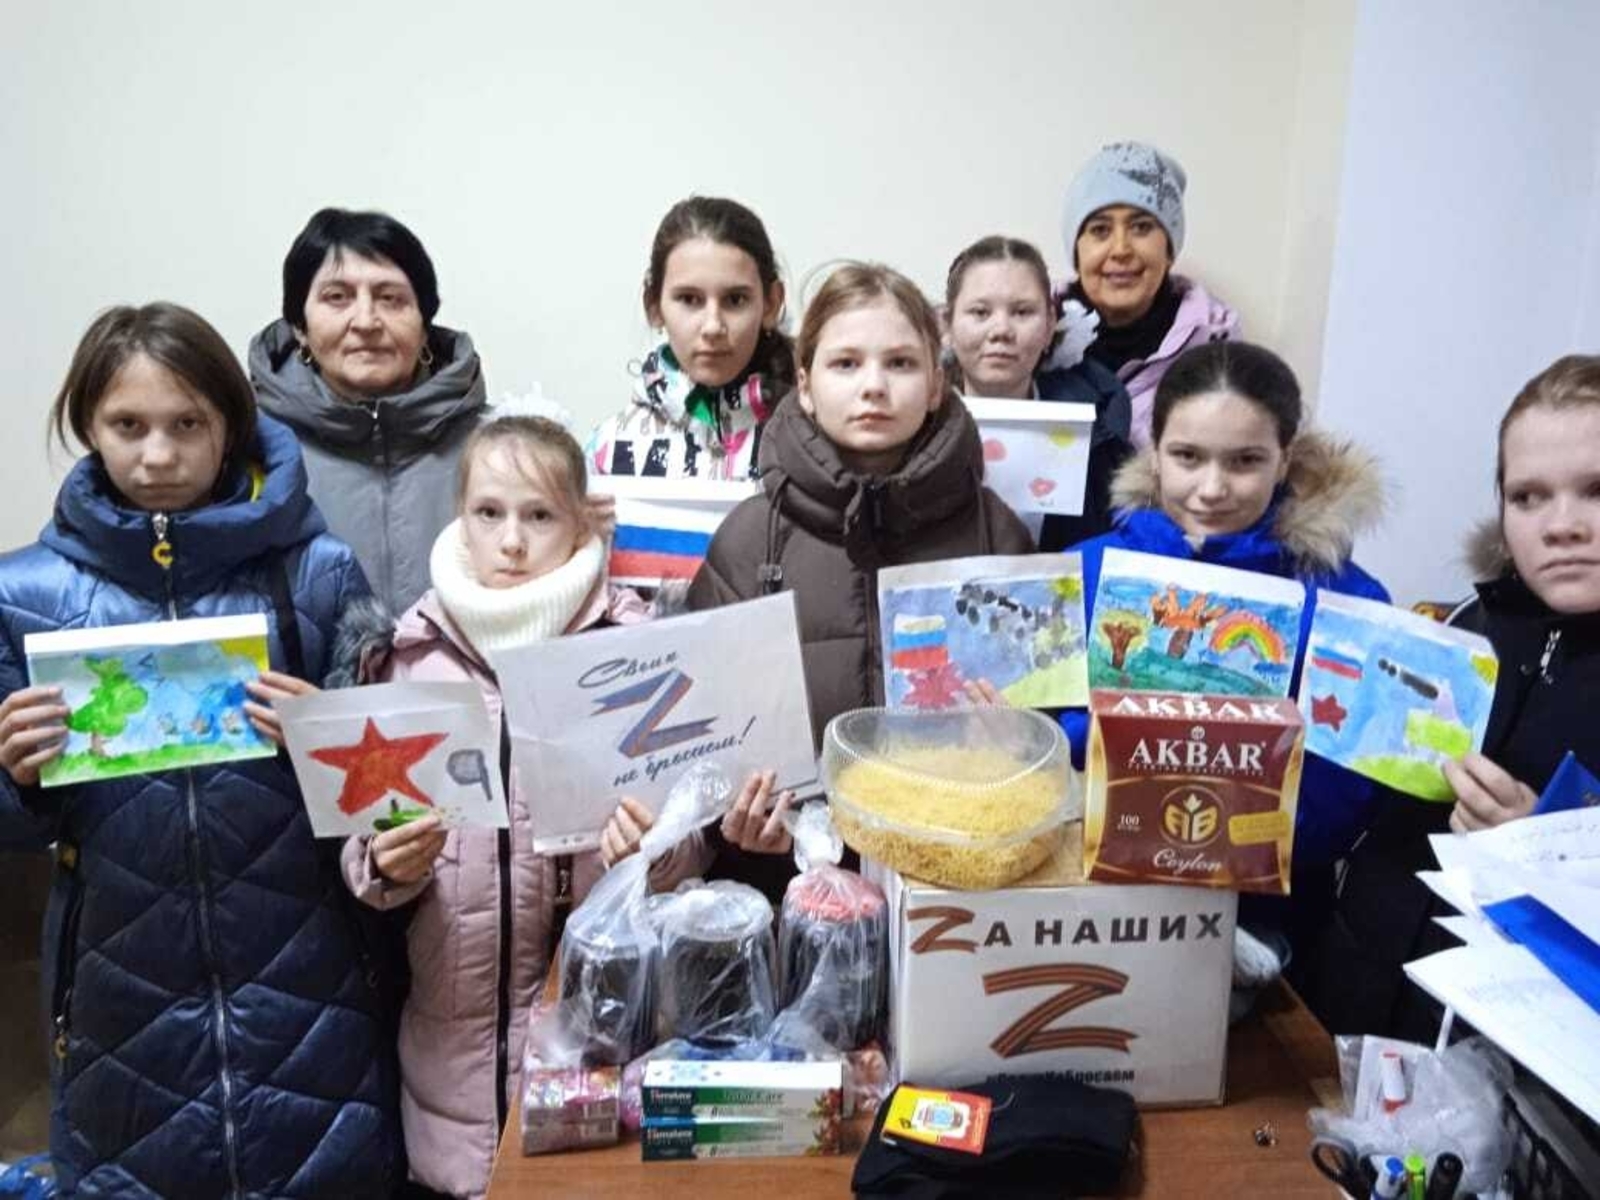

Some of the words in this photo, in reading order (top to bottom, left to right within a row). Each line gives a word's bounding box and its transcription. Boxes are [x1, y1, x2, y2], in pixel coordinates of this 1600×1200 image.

[1112, 695, 1286, 721] AKBAR
[1128, 738, 1263, 771] AKBAR
[613, 767, 639, 788] не
[1119, 814, 1140, 826] 100
[1152, 848, 1223, 875] Ceylon
[1034, 912, 1223, 946] НАШИХ
